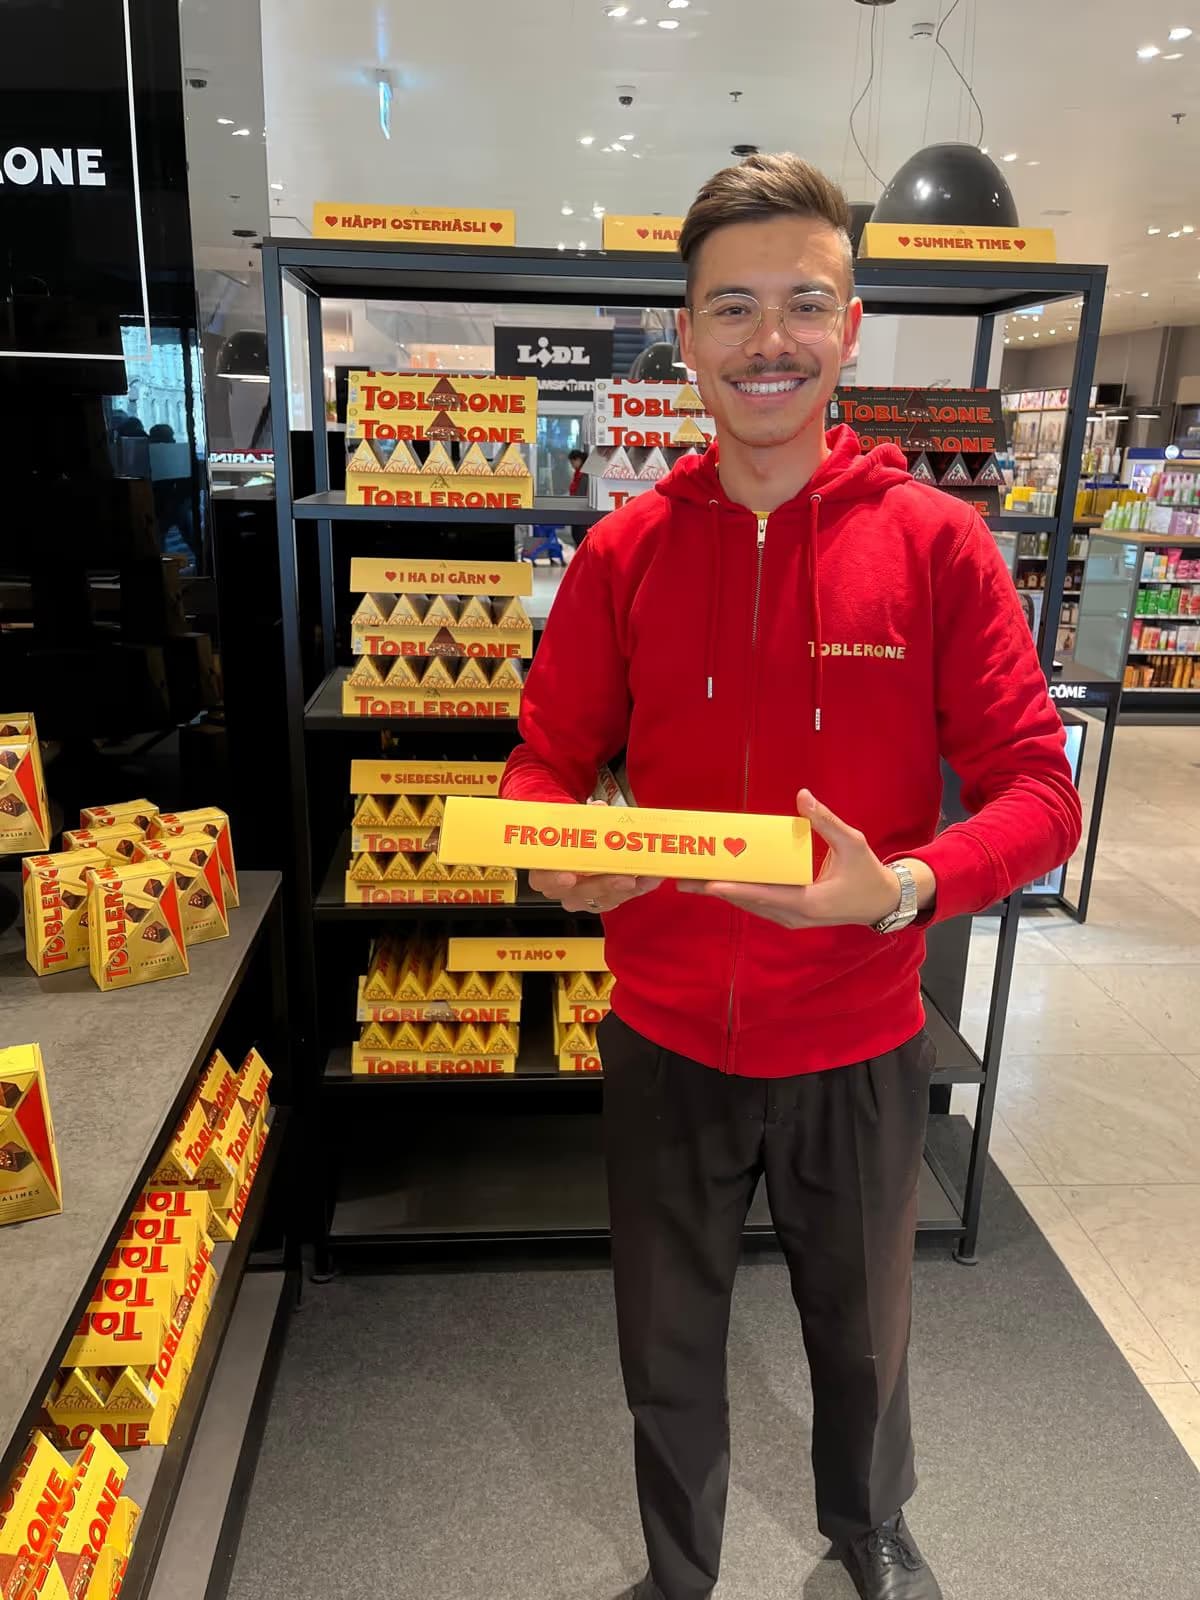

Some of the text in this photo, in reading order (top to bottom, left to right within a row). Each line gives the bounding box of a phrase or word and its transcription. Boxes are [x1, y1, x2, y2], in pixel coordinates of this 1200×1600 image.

[0, 146, 106, 186] ONE
[341, 215, 487, 233] HÄPPI OSTERHÄSLI
[913, 237, 1012, 250] SUMMER TIME
[360, 386, 526, 413] TOBLRONE
[839, 400, 994, 424] TOBLRONE
[359, 420, 526, 443] TOBLRONE
[358, 486, 522, 508] TOBLERONE
[400, 571, 487, 585] I HA DI GÄRN
[365, 636, 522, 658] TOBLRONE
[355, 696, 511, 717] TOBLERONE
[504, 824, 717, 857] FROHE OSTERN
[357, 885, 505, 903] TOBLERONE
[510, 950, 553, 960] TI AMO
[368, 1004, 511, 1023] TOBLRONE
[363, 1056, 505, 1075] TOBLERONE
